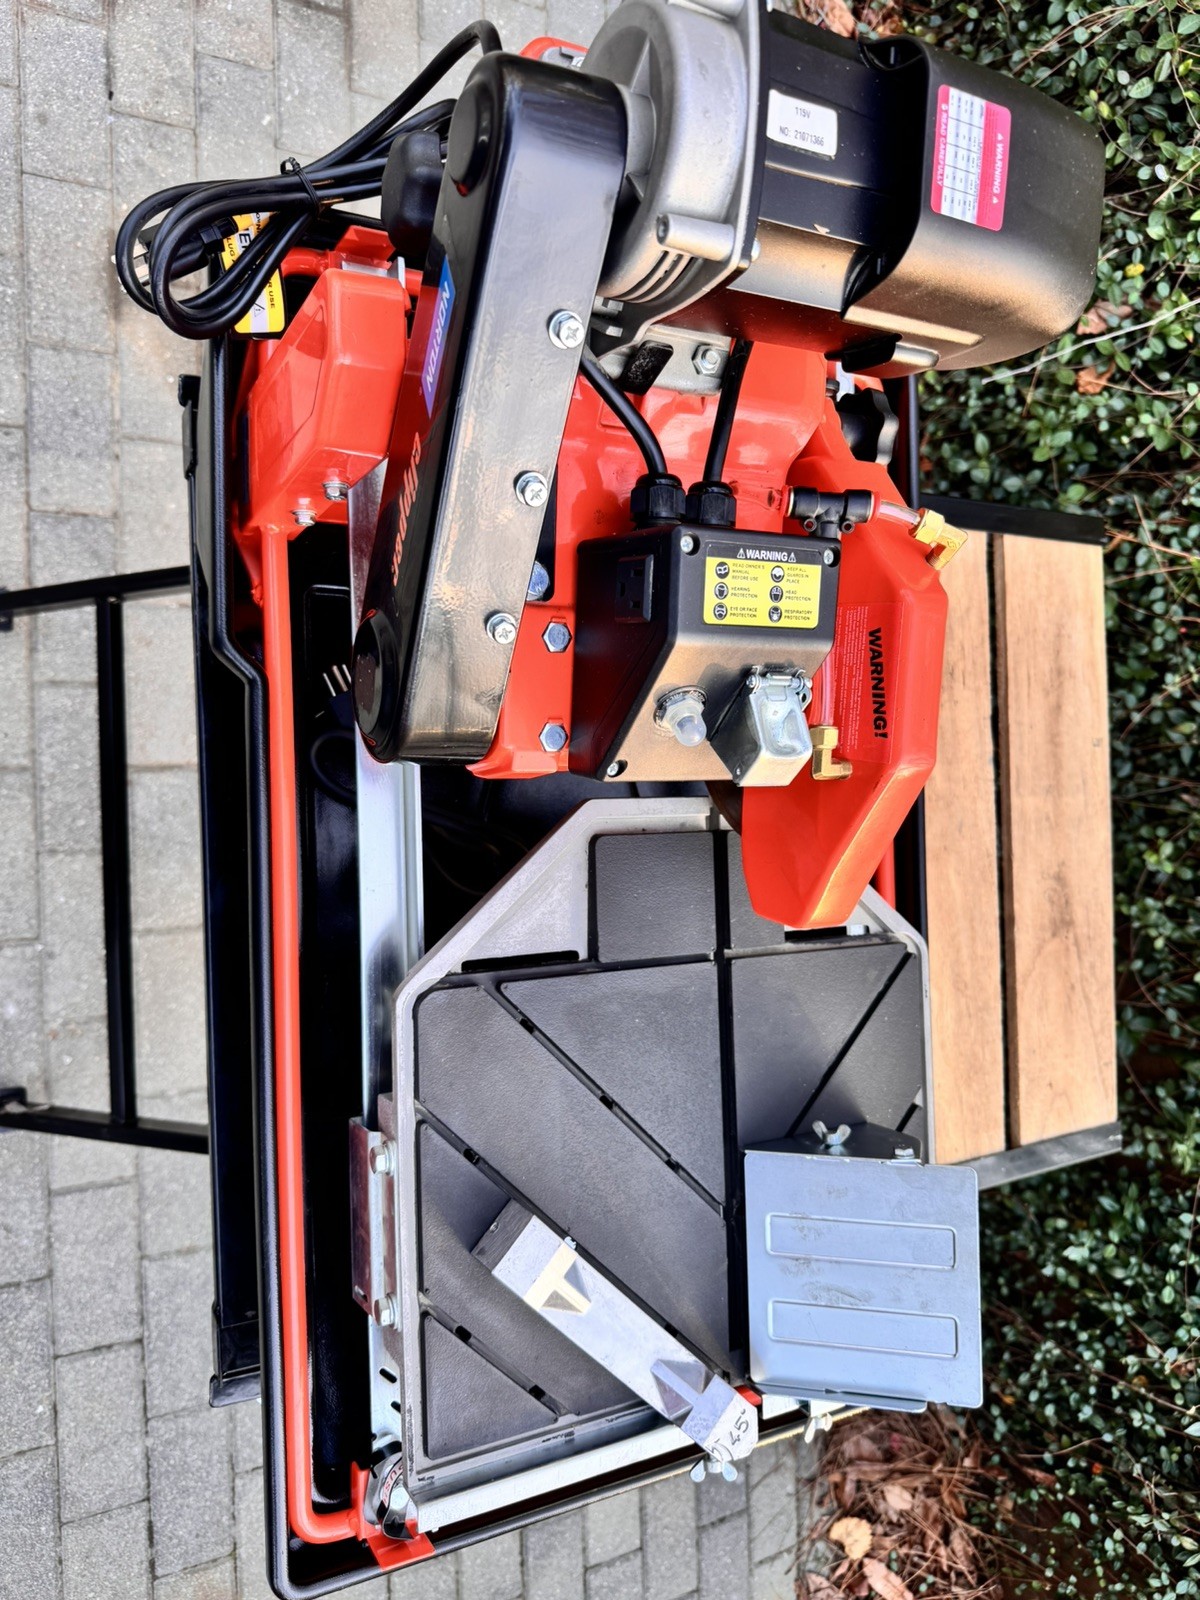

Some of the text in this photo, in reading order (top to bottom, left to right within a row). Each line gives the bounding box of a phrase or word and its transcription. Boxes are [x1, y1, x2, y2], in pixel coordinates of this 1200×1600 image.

[779, 125, 791, 137] NO:
[795, 106, 811, 119] 115V
[937, 112, 948, 187] READ CAREFULLY
[993, 143, 1004, 194] WARNING
[426, 281, 450, 392] NORTON
[746, 548, 788, 562] WARNING
[868, 627, 889, 740] WARNING!
